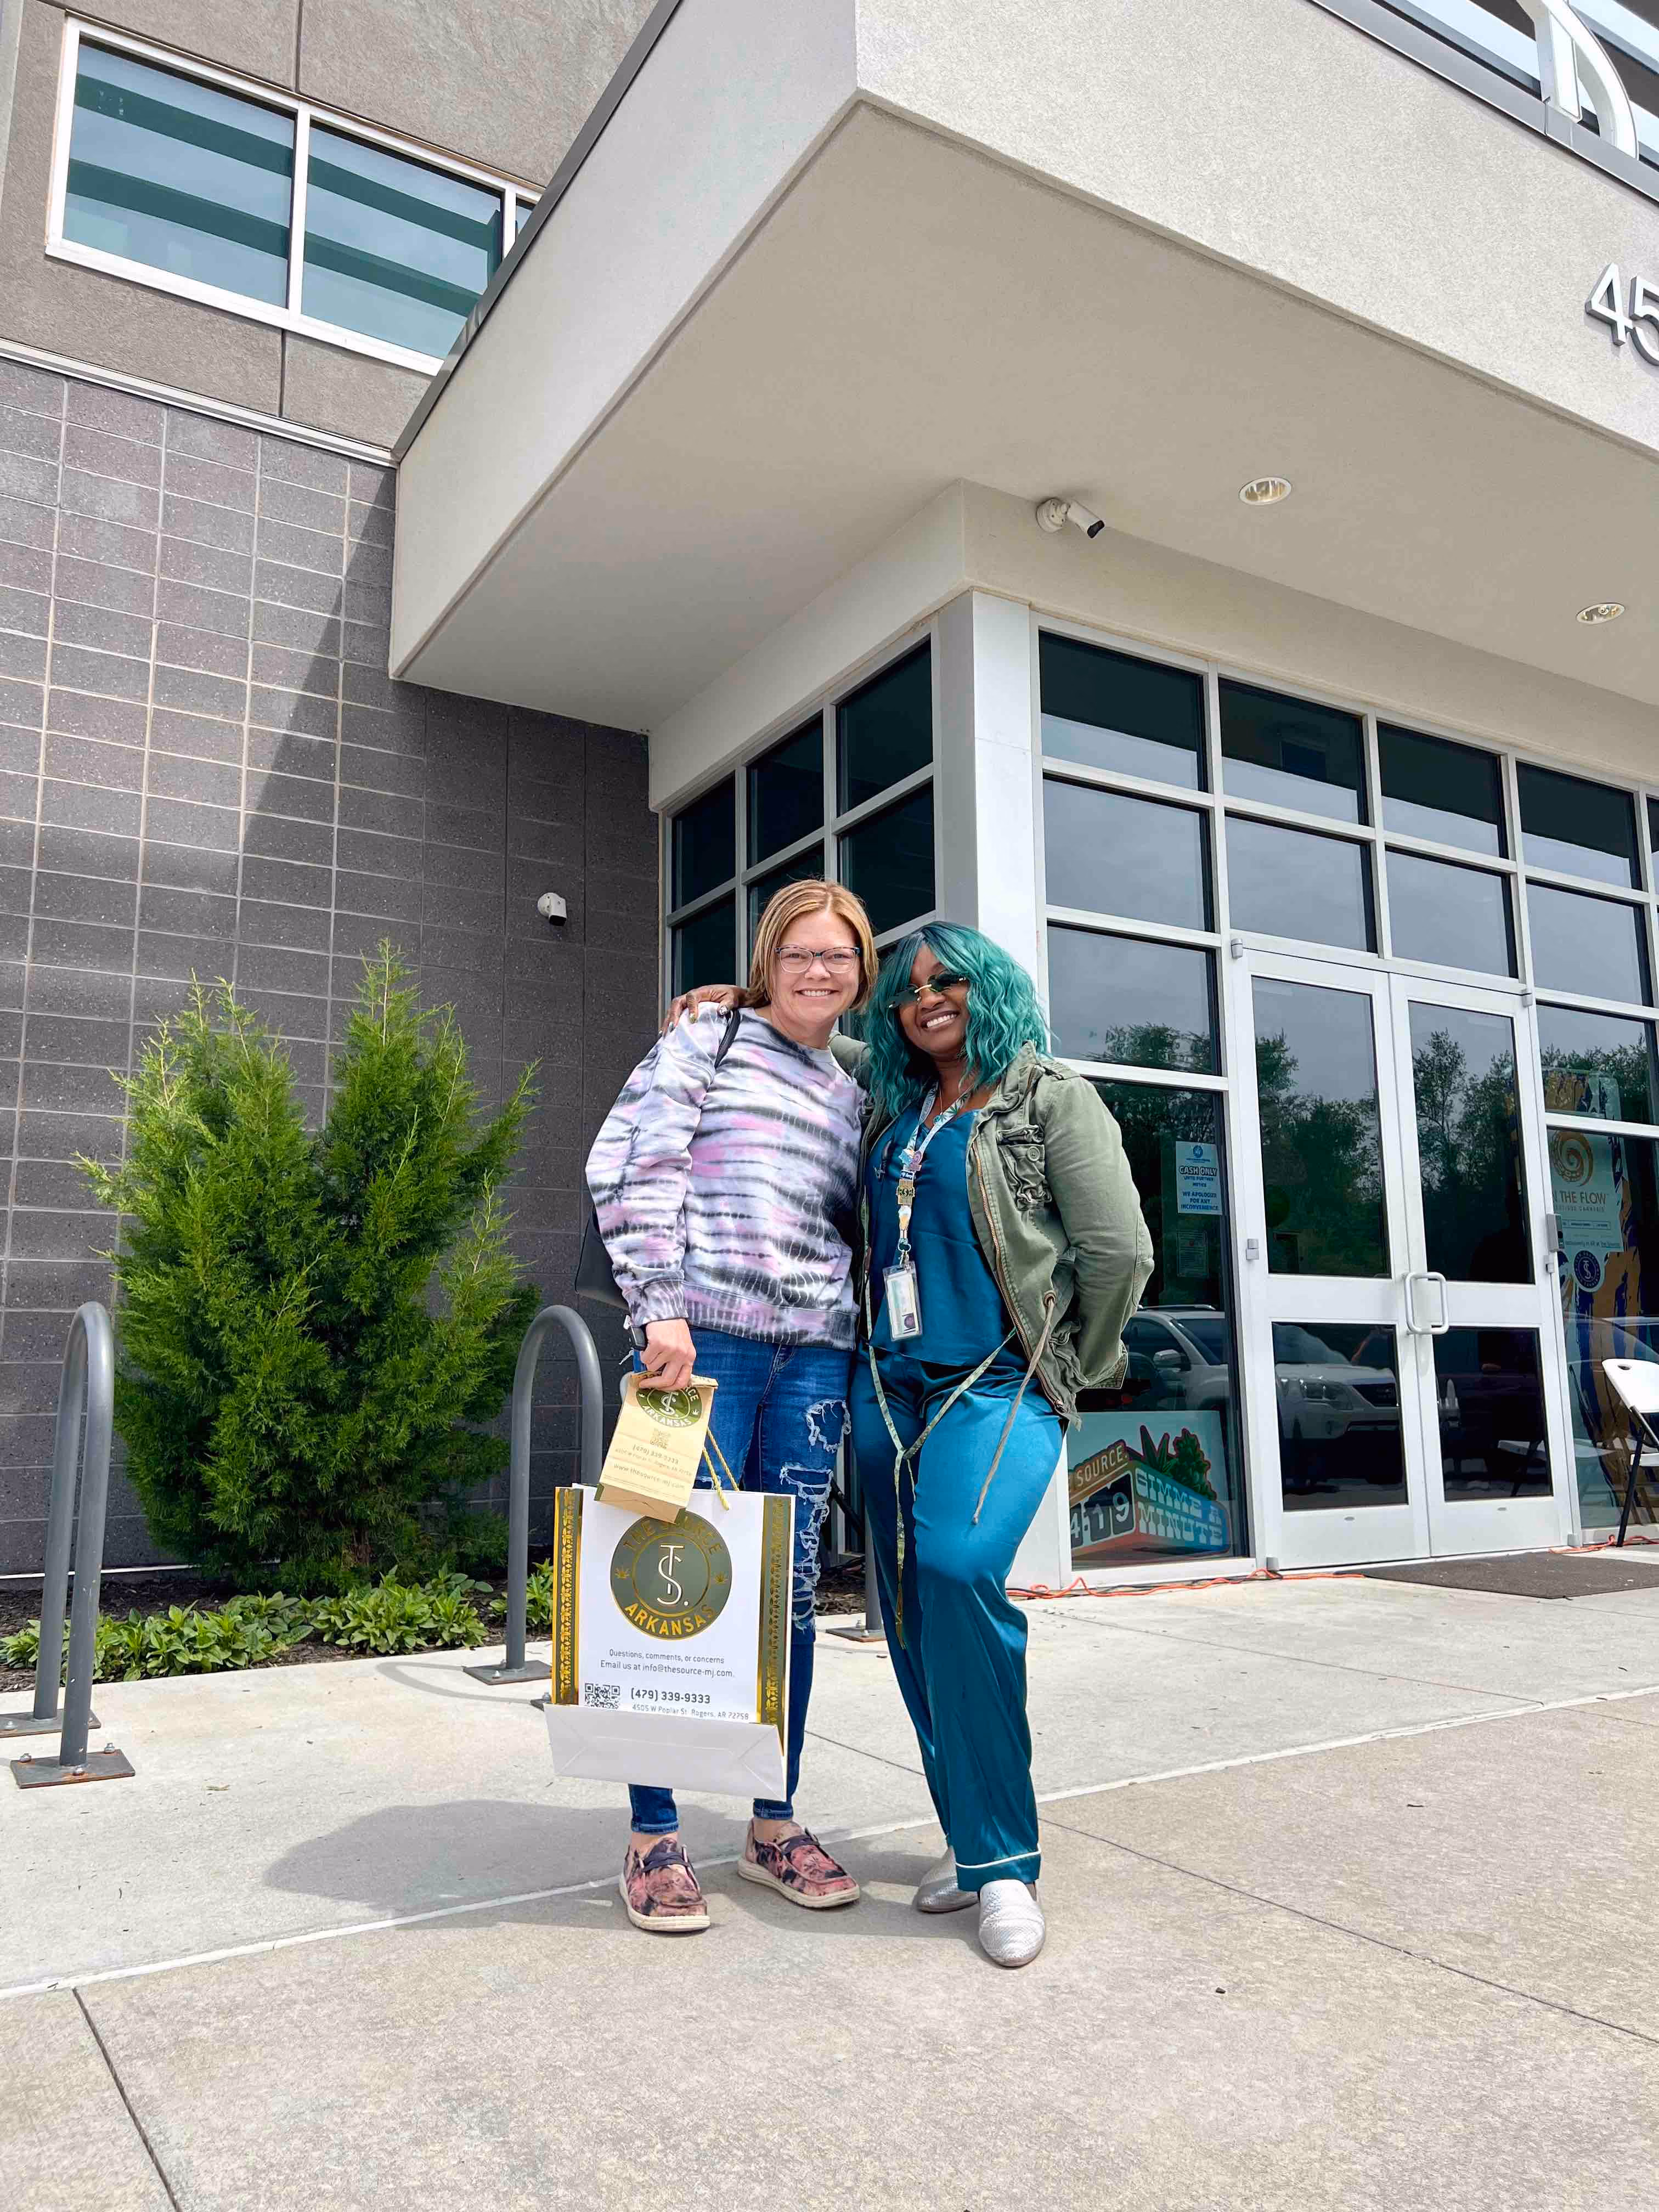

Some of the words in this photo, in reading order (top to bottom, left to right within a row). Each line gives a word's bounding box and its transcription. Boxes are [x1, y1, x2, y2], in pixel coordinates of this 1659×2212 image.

[1179, 1165, 1199, 1175] CASH
[1200, 1166, 1217, 1176] ONLY
[1559, 1190, 1577, 1203] THE
[1580, 1191, 1606, 1205] FLOW
[642, 1404, 692, 1427] ARKANSAS
[1135, 1468, 1203, 1519] GIMME
[1209, 1505, 1222, 1527] A
[1137, 1501, 1223, 1545] MINUTE
[623, 1520, 656, 1551] THE
[624, 1602, 715, 1635] ARKANSAS
[610, 1649, 644, 1660] Questions,
[646, 1653, 683, 1662] comments,
[601, 1660, 621, 1668] Email
[631, 1688, 658, 1702] (479)
[661, 1691, 710, 1704] 339-9333
[658, 1706, 679, 1714] Poplar
